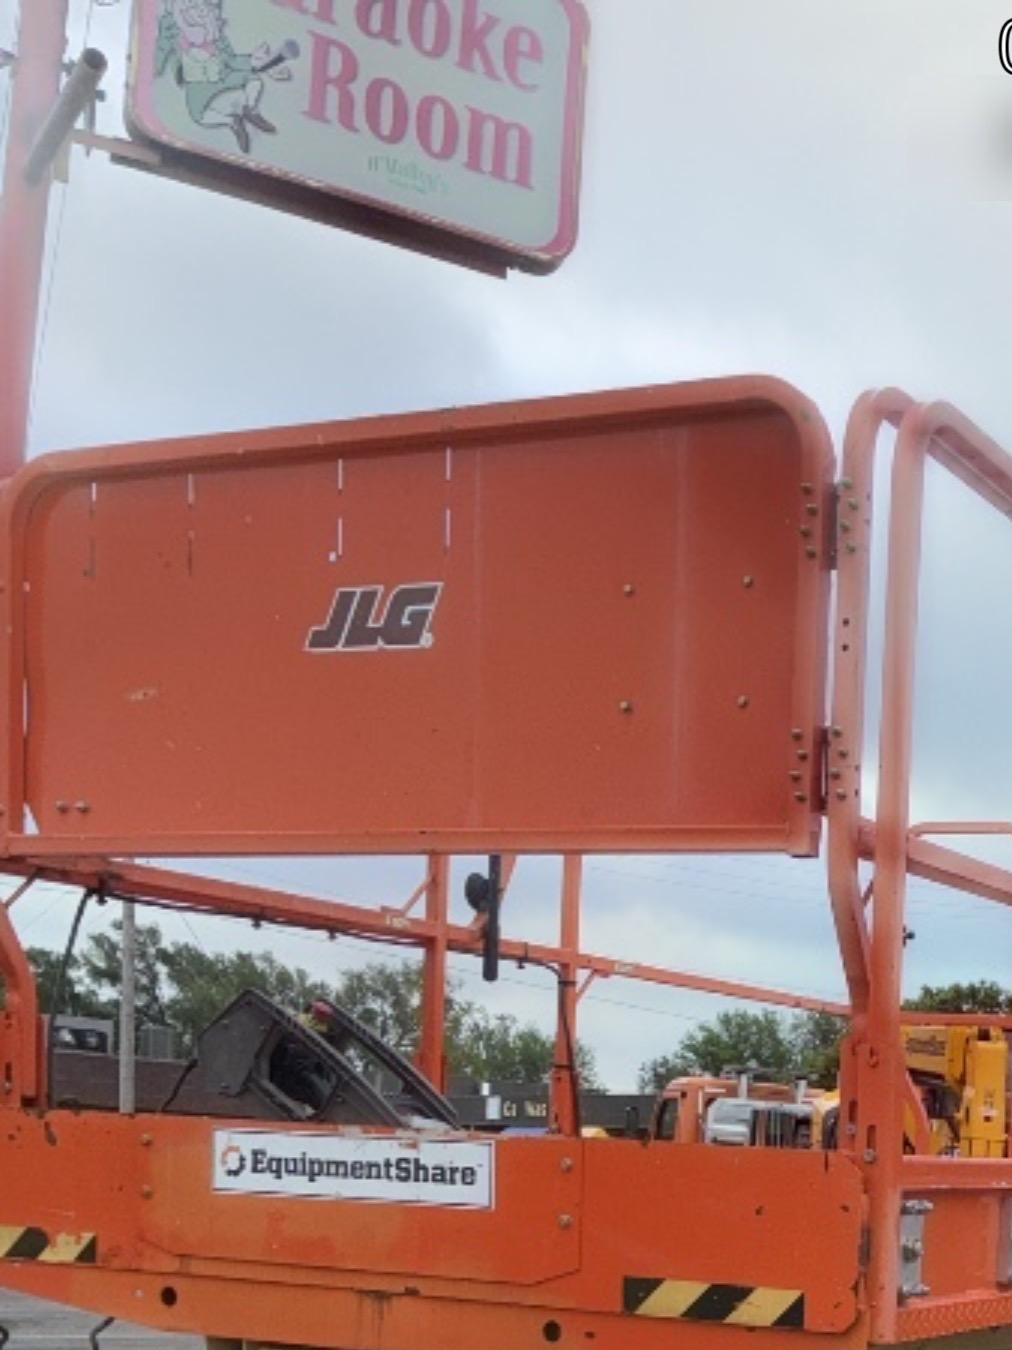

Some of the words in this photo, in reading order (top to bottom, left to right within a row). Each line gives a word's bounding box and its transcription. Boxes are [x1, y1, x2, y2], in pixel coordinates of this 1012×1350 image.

[302, 30, 535, 190] Room
[302, 581, 444, 653] JLG
[250, 1148, 478, 1187] EquipmentShare
